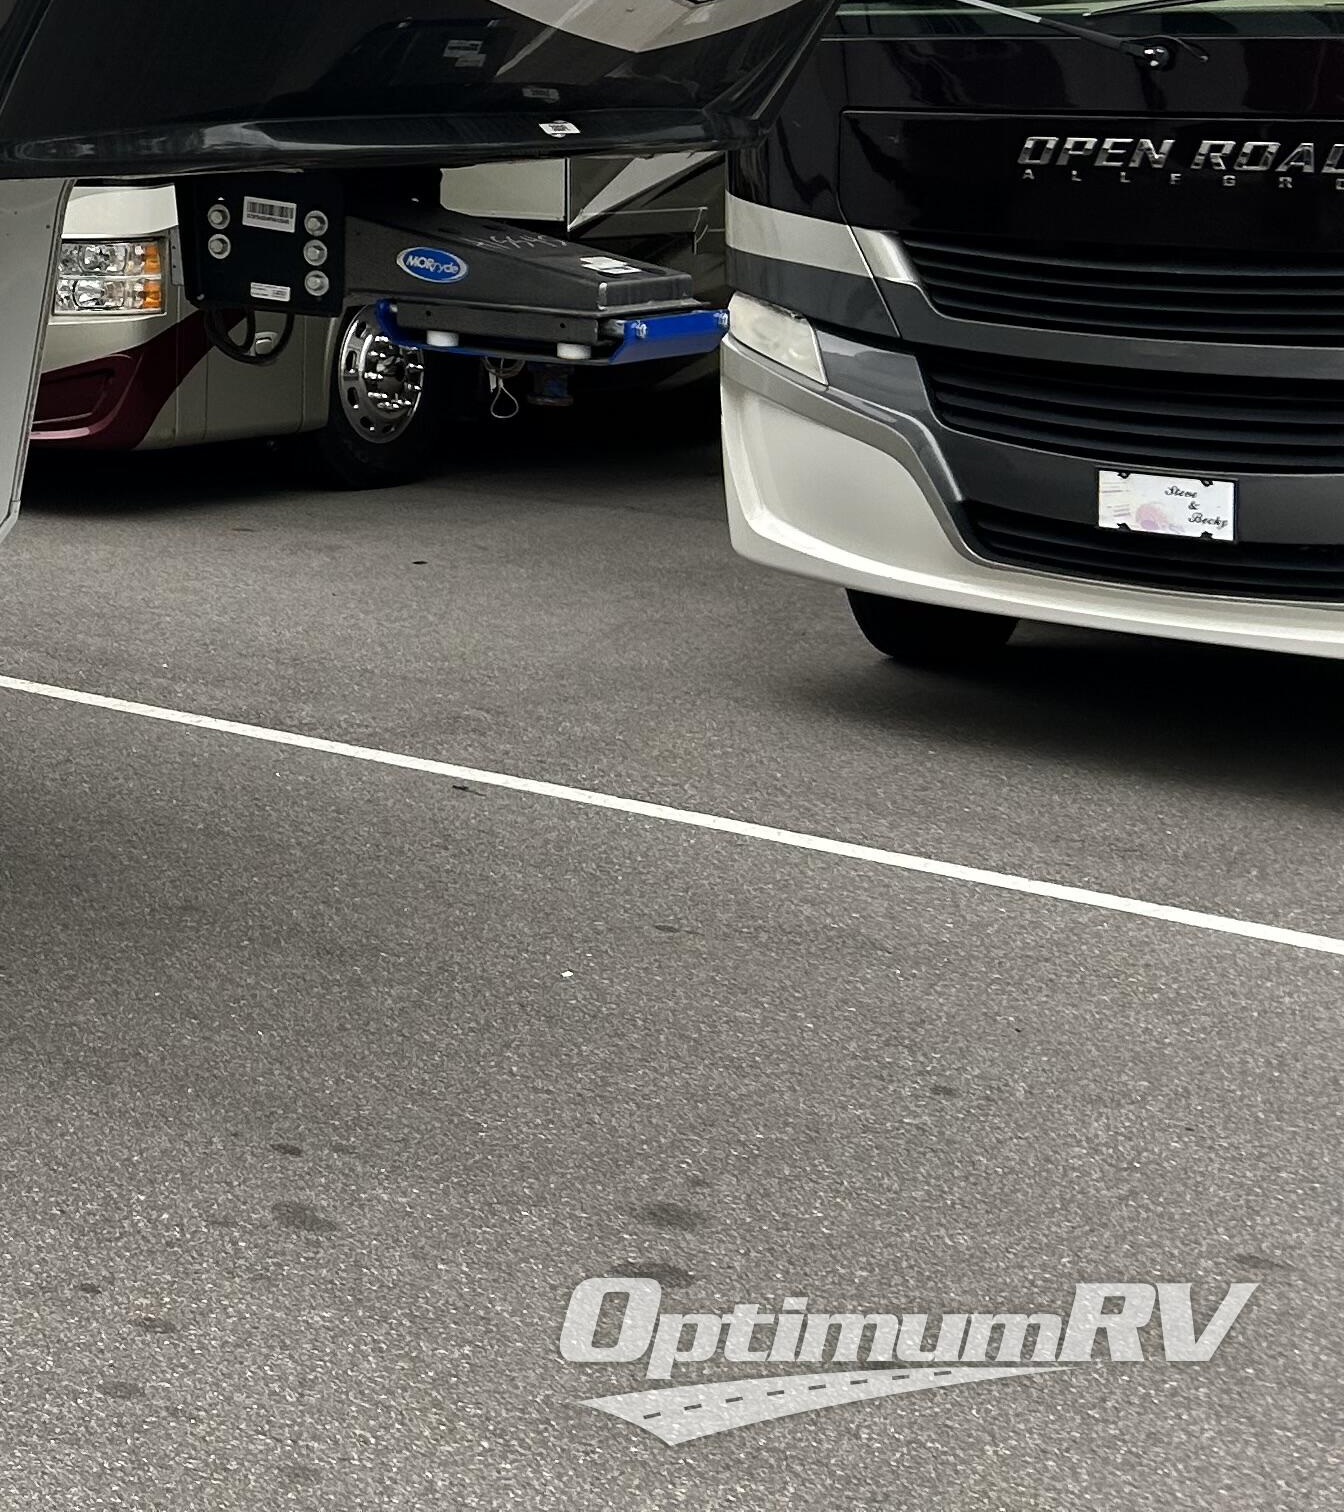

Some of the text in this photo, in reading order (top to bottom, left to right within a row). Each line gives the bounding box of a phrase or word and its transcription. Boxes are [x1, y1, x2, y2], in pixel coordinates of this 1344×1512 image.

[1017, 136, 1176, 169] OPEN
[1164, 485, 1198, 499] Steve
[1188, 501, 1200, 511] &
[1188, 512, 1229, 529] Becky
